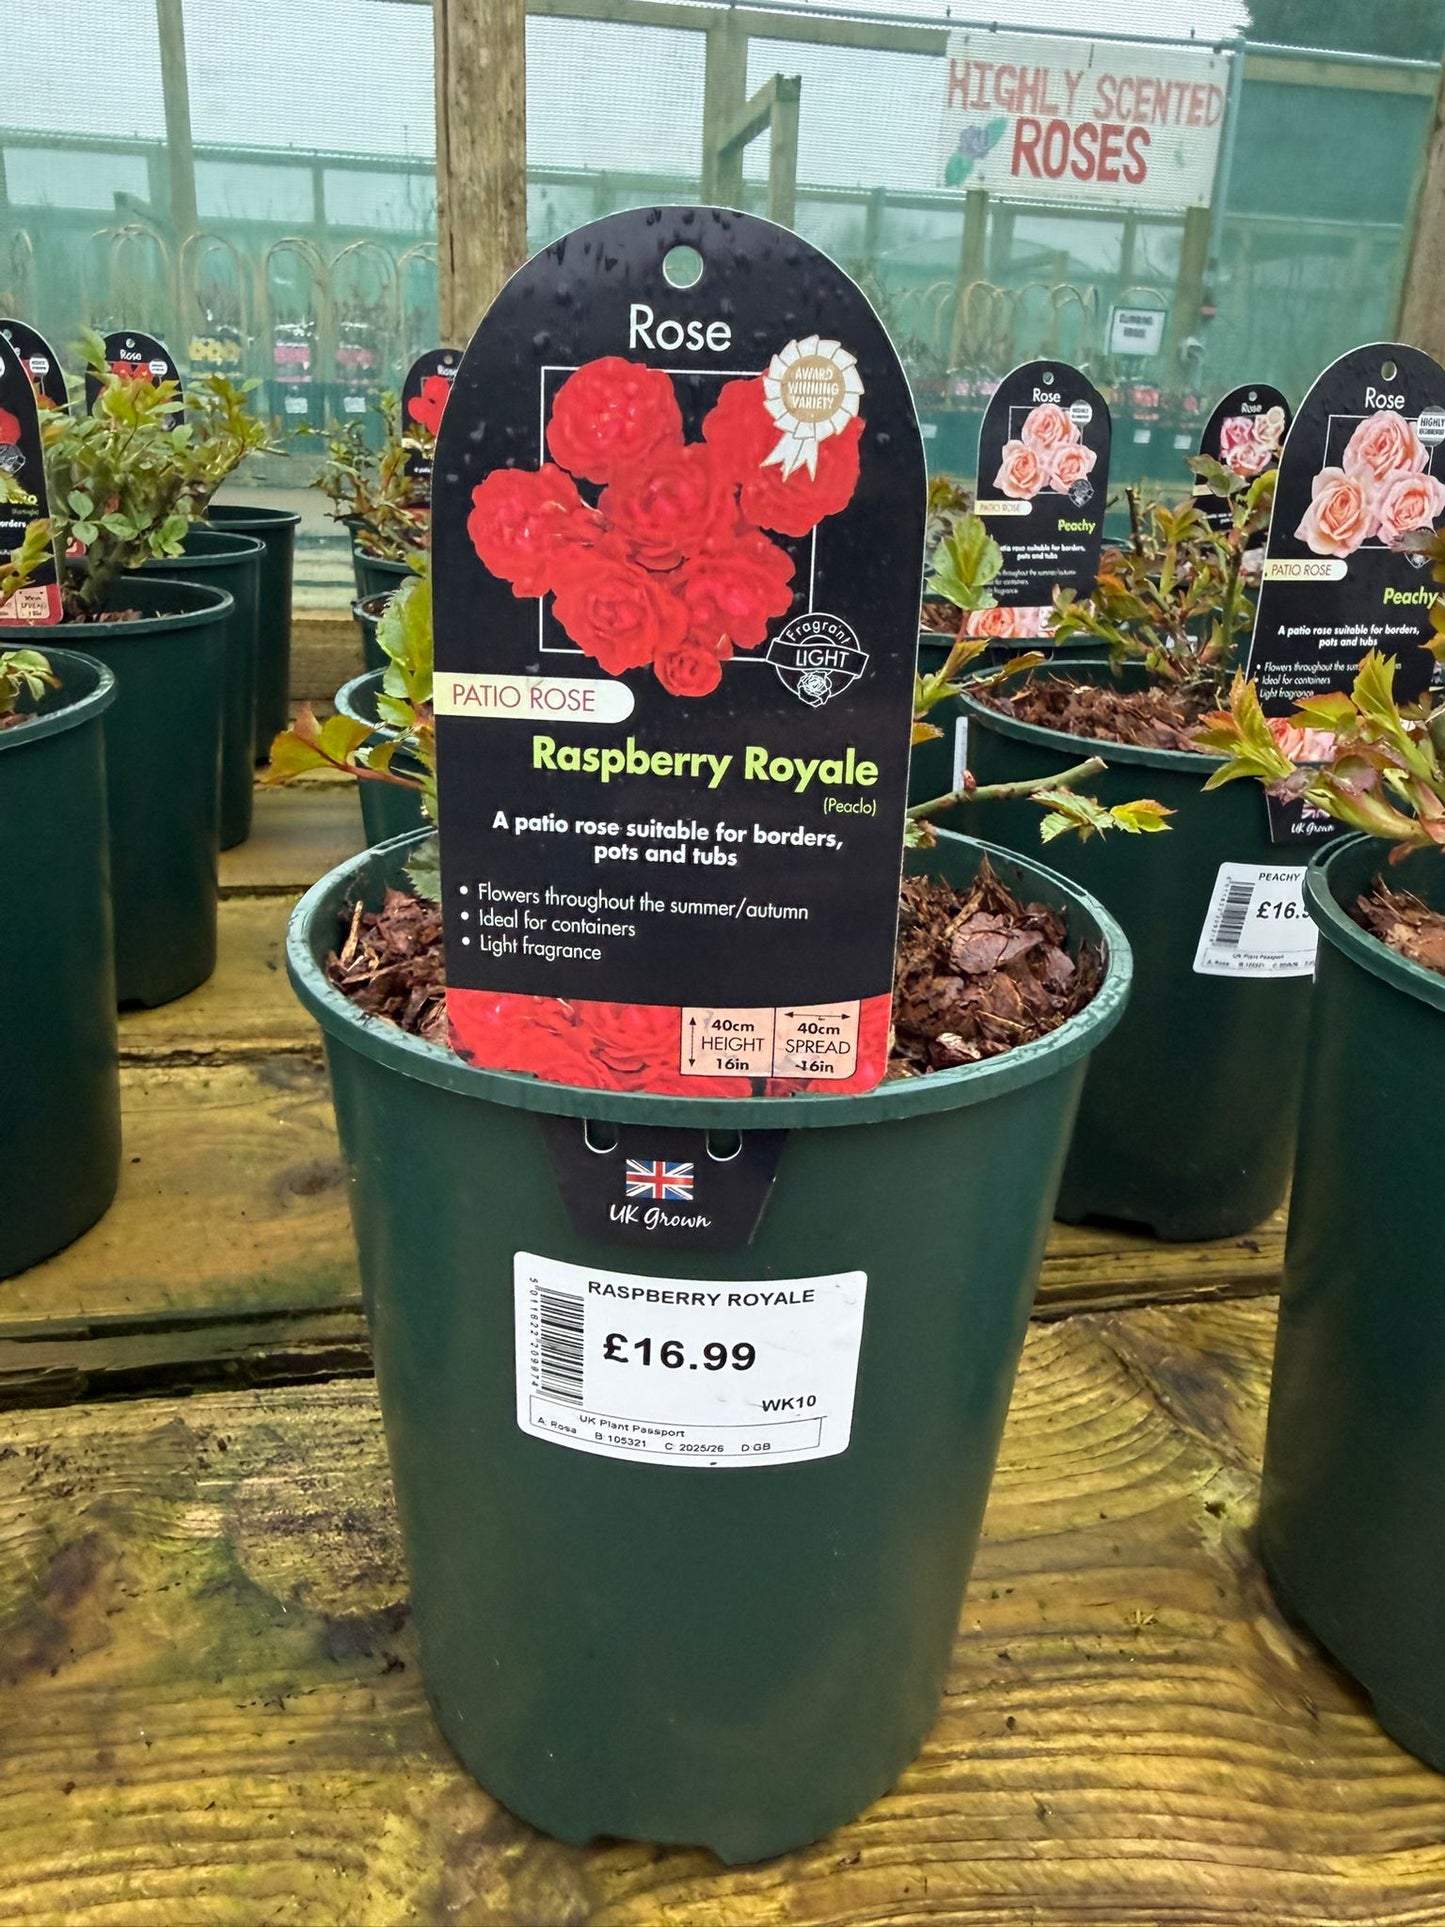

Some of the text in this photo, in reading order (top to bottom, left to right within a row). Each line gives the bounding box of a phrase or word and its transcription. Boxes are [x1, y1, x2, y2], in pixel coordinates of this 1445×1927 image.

[947, 59, 1224, 127] HIGHLY SCENTED
[1011, 115, 1150, 185] ROSES
[629, 303, 732, 352] Rose
[795, 366, 833, 380] AWARD
[788, 381, 839, 396] WINNING
[1032, 387, 1061, 403] Rose
[792, 396, 834, 410] VARIETY
[1365, 386, 1405, 410] Rose
[1420, 417, 1445, 427] HIGHLY
[1058, 518, 1096, 535] Peachy
[1271, 563, 1332, 577] PATIO ROSE
[1383, 586, 1439, 610] Peachy
[785, 620, 851, 645] Fragrant
[1278, 624, 1420, 638] A patio rose suitable for borders,
[1319, 636, 1378, 649] pots and tubs
[796, 649, 849, 668] LIGHT
[1264, 661, 1292, 672] Flowers
[1293, 661, 1333, 675] throughout
[1333, 661, 1344, 672] the
[1262, 674, 1331, 685] Ideal for containers
[452, 683, 595, 712] PATIO ROSE
[1259, 688, 1278, 700] Light
[533, 735, 879, 793] Raspberry Royale
[823, 797, 877, 817] (Peaclo)
[492, 810, 843, 850] A patio rose suitable for borders,
[1291, 822, 1305, 834] UK
[594, 843, 737, 867] pots and tubs
[1258, 872, 1301, 882] PEACHY
[478, 881, 809, 920] Flowers throughout the summer/autumn
[1256, 901, 1310, 919] £16.
[480, 907, 636, 937] Ideal for containers
[480, 934, 602, 961] Light fragrance
[711, 1018, 755, 1032] 40cm
[797, 1022, 840, 1036] 40cm
[701, 1036, 764, 1052] HEIGHT
[785, 1039, 851, 1055] SPREAD
[716, 1058, 749, 1071] 16in
[801, 1059, 834, 1073] 16in
[609, 1203, 712, 1231] UK Grown
[588, 1281, 815, 1307] RASPBERRY ROYALE
[603, 1332, 756, 1371] £16.99
[762, 1395, 817, 1412] WK10
[579, 1415, 685, 1438] UK Plant Passport
[550, 1420, 577, 1434] Rosa
[608, 1435, 646, 1448] 105321
[679, 1443, 724, 1453] 2025/26
